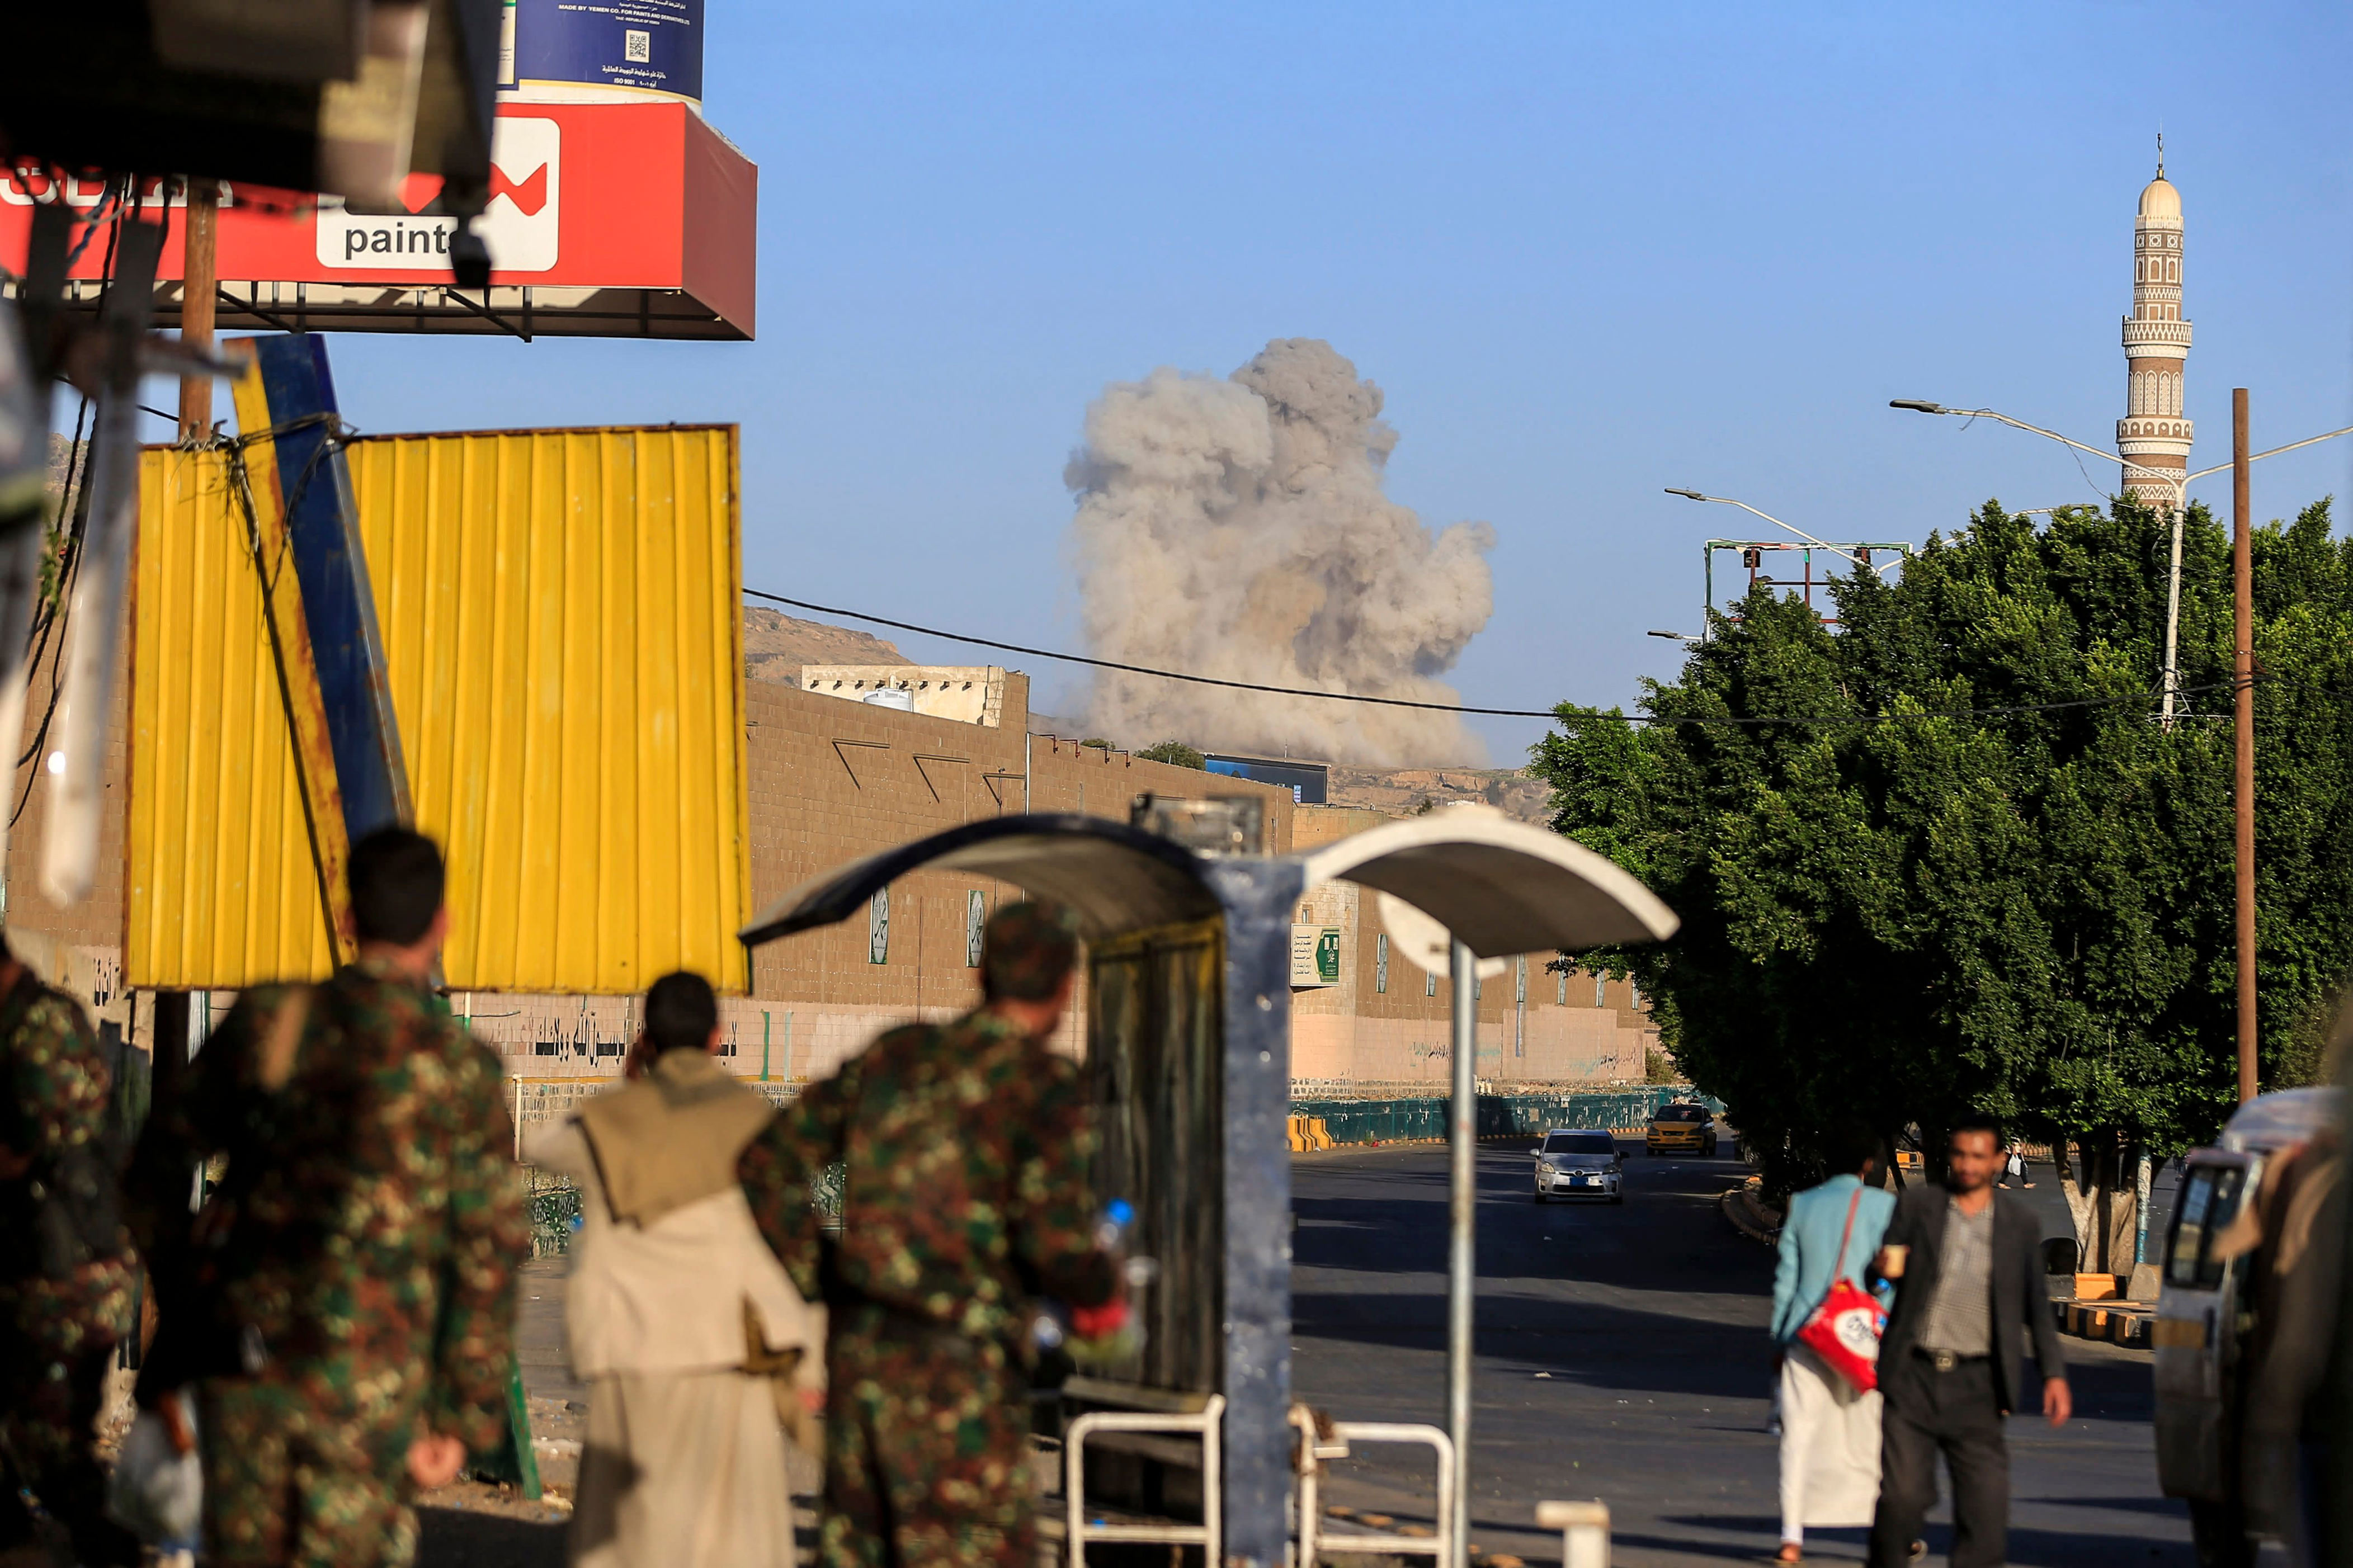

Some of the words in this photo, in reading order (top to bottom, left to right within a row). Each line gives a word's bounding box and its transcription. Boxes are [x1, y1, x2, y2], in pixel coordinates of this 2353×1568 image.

[602, 65, 619, 74] العالمية
[619, 67, 634, 75] الجودة
[345, 221, 451, 261] paint
